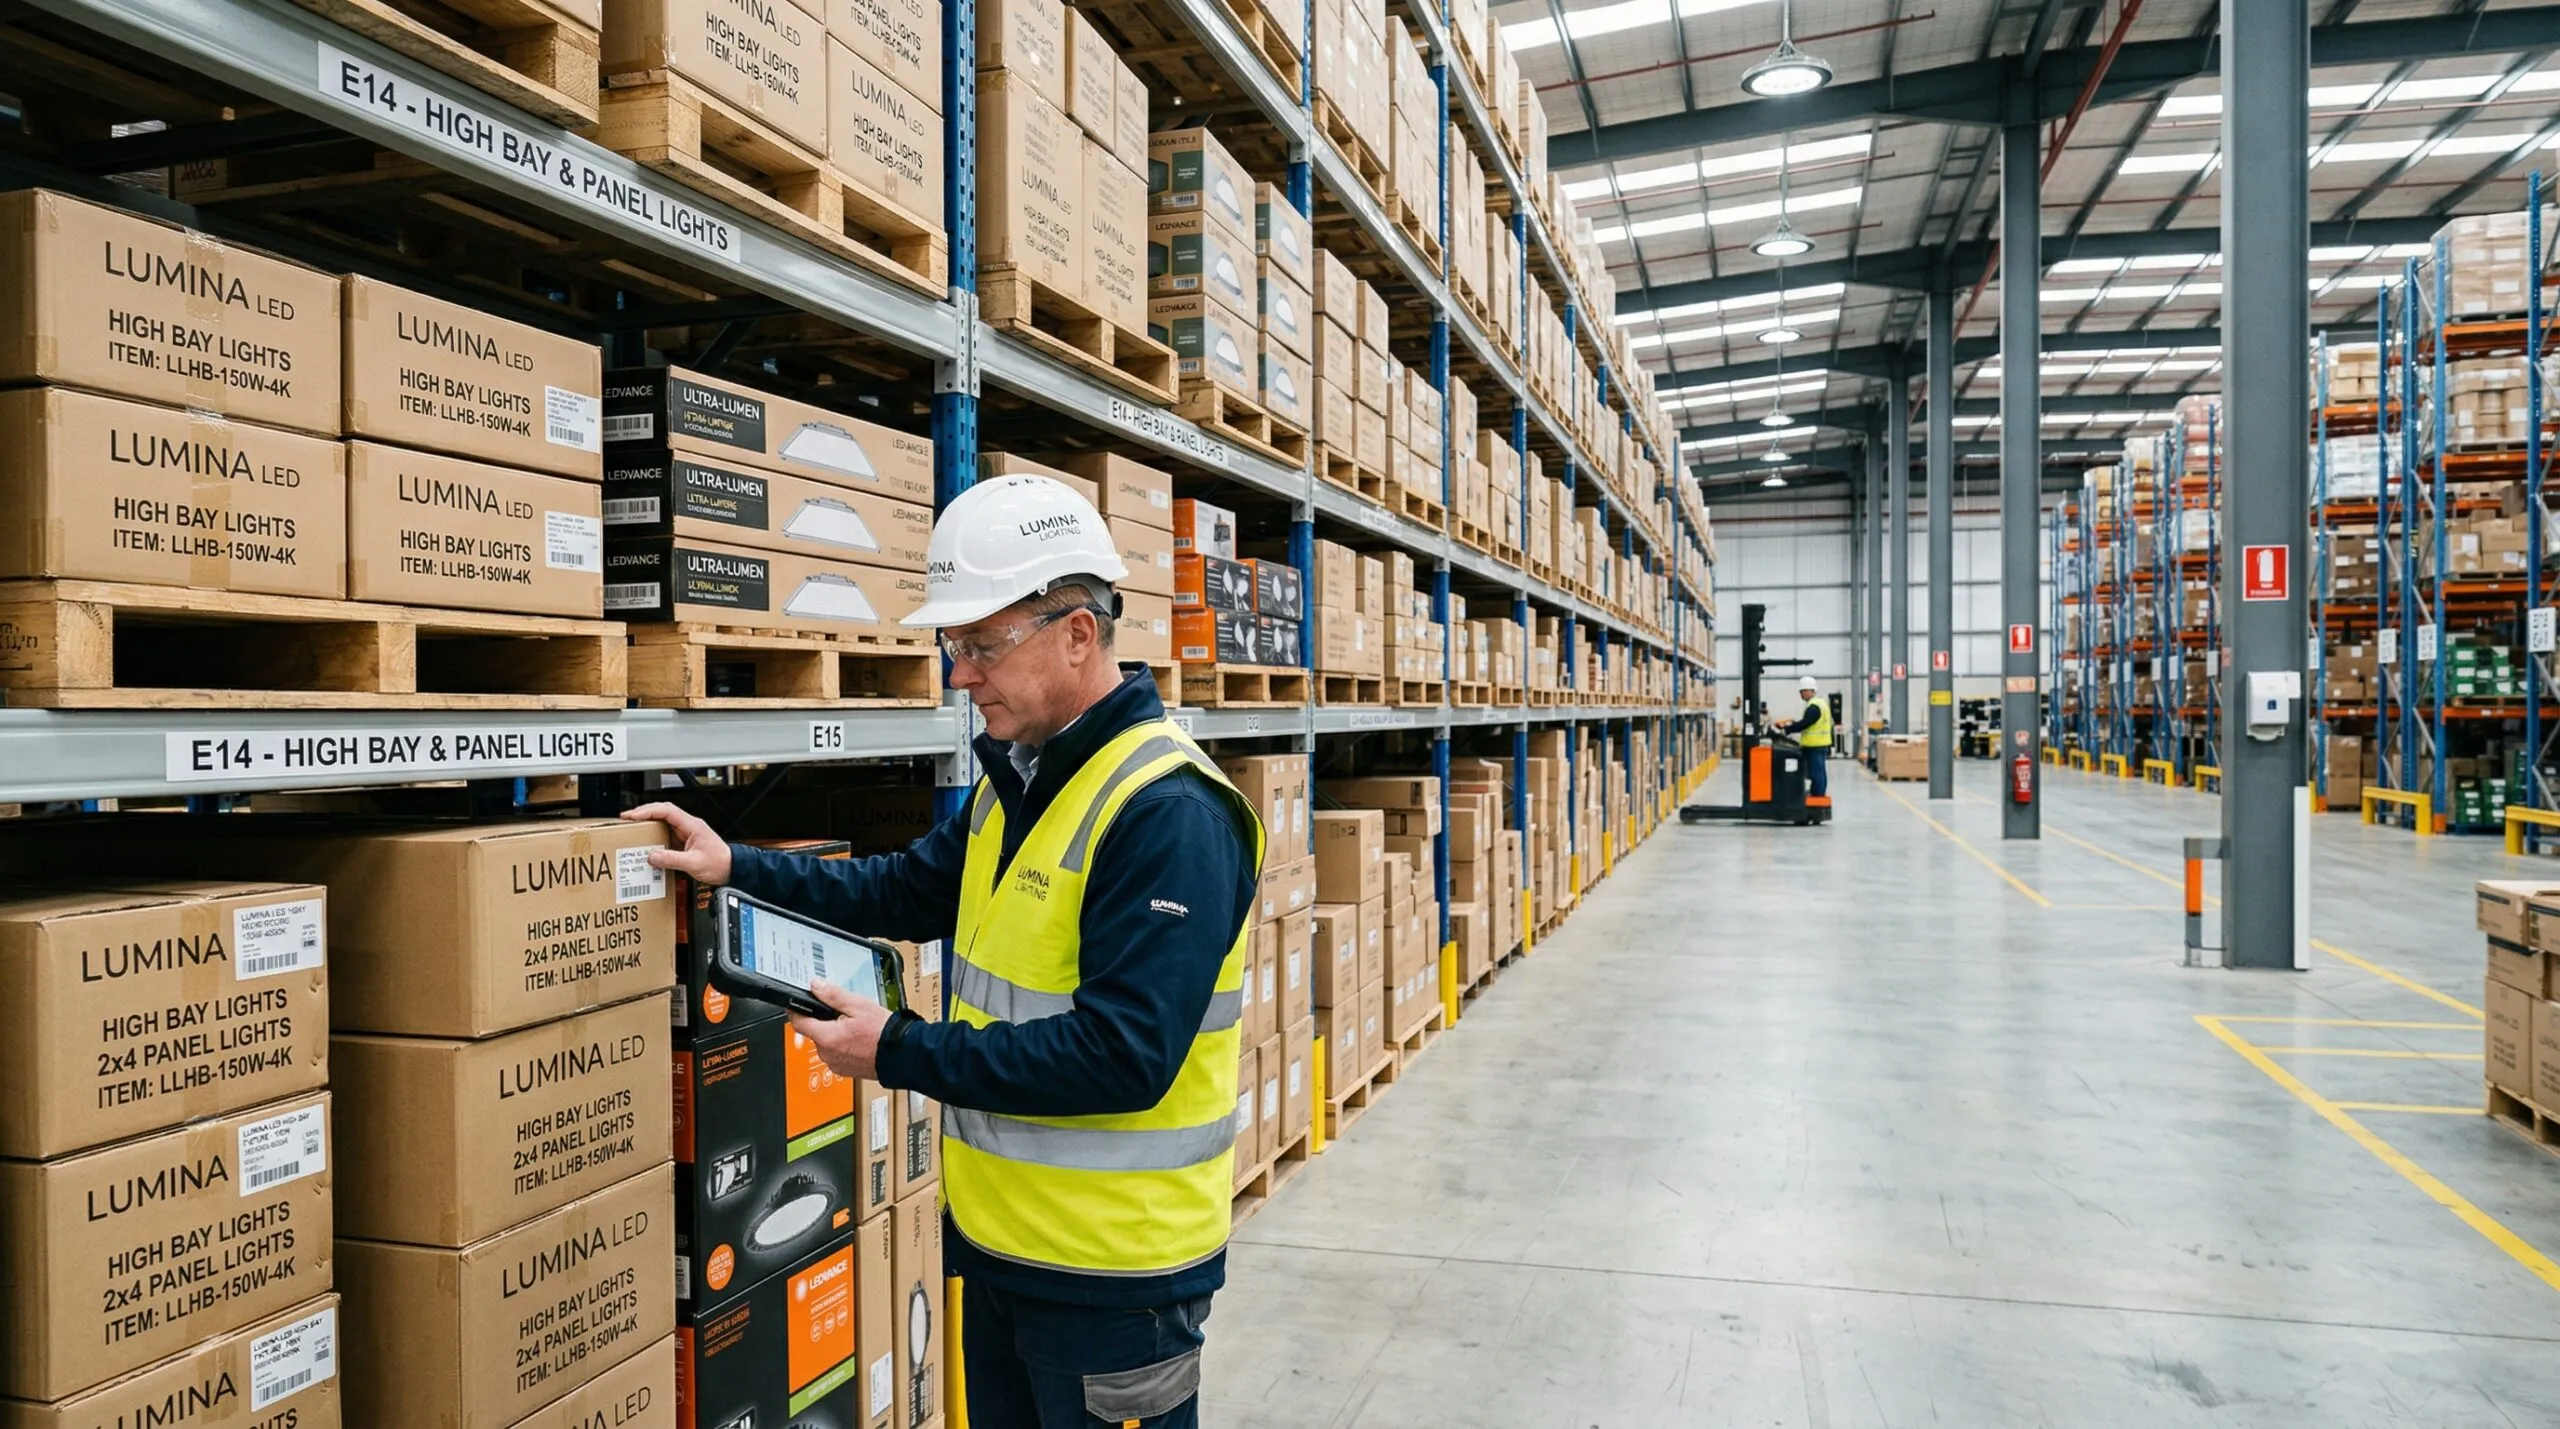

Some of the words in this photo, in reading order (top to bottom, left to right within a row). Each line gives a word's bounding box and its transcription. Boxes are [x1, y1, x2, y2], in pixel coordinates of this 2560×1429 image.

[706, 11, 734, 44] HIGH
[738, 32, 760, 59] BAY
[762, 47, 799, 84] LIGHTS
[706, 37, 732, 65] ITEM:
[779, 14, 800, 46] LED
[852, 70, 906, 126] LUMINA
[341, 61, 396, 112] E14
[408, 105, 416, 113] -
[426, 102, 493, 152] HIGH
[504, 132, 551, 176] BAY
[559, 159, 575, 188] &
[584, 167, 653, 221] PANEL
[660, 200, 728, 250] LIGHTS
[106, 241, 250, 309] LUMINA
[257, 295, 295, 320] LED
[109, 309, 164, 342] HIGH
[172, 324, 213, 352] BAY
[220, 336, 291, 372] LIGHTS
[398, 312, 500, 364] LUMINA
[506, 351, 534, 372] LED
[109, 341, 160, 369] ITEM:
[167, 354, 291, 398] LLHB-150W-4K
[400, 367, 440, 394] HIGH
[444, 378, 474, 401] BAY
[479, 386, 531, 414] LIGHTS
[604, 385, 654, 398] EDVANCE
[400, 394, 436, 417] ITEM:
[441, 403, 531, 437] LLHB-150W-4K
[684, 387, 760, 420] ULTRA-LUMEN
[111, 429, 254, 482] LUMINA
[262, 464, 300, 488] LED
[608, 468, 662, 480] LEDVANCE
[686, 468, 763, 497] ULTRA-LUMEN
[114, 496, 168, 524] HIGH
[176, 505, 218, 530] BAY
[225, 511, 296, 539] LIGHTS
[399, 474, 500, 515] LUMINA
[506, 500, 533, 520] LED
[114, 529, 165, 552] ITEM:
[172, 535, 296, 566] LLHB-150W-4K
[400, 530, 440, 552] HIGH
[445, 535, 475, 556] BAY
[480, 540, 531, 562] LIGHTS
[1020, 514, 1079, 536] LUMINA
[400, 556, 436, 576] ITEM:
[442, 561, 532, 584] LLHB-150W-4K
[608, 554, 660, 566] LEDVANCE
[688, 556, 764, 579] ULTRA-LUMEN
[193, 739, 252, 771] E14
[285, 737, 358, 766] HIGH
[368, 736, 421, 763] BAY
[429, 737, 447, 761] &
[456, 734, 531, 760] PANEL
[540, 732, 614, 759] LIGHTS
[814, 726, 842, 748] E15
[850, 808, 929, 826] LUMINA
[512, 852, 612, 894] LUMINA
[528, 916, 561, 940] HIGH
[565, 913, 590, 934] BAY
[594, 905, 638, 928] LIGHTS
[82, 933, 227, 982] LUMINA
[524, 946, 548, 967] 2x4
[552, 940, 594, 961] PANEL
[598, 928, 641, 951] LIGHTS
[525, 971, 558, 992] ITEM:
[562, 951, 642, 984] LLHB-150W-4K
[103, 1012, 158, 1042] HIGH
[166, 1002, 209, 1030] BAY
[216, 988, 288, 1020] LIGHTS
[98, 1048, 137, 1076] 2x4
[144, 1034, 214, 1066] PANEL
[220, 1017, 292, 1050] LIGHTS
[500, 1042, 604, 1100] LUMINA
[610, 1034, 645, 1065] LED
[98, 1078, 154, 1108] ITEM:
[160, 1046, 292, 1094] LLHB-150W-4K
[517, 1115, 551, 1142] HIGH
[556, 1105, 582, 1129] BAY
[586, 1089, 631, 1119] LIGHTS
[514, 1147, 537, 1170] 2x4
[542, 1131, 585, 1160] PANEL
[590, 1112, 634, 1142] LIGHTS
[514, 1171, 548, 1196] ITEM:
[552, 1135, 634, 1181] LLHB-150W-4K
[88, 1154, 228, 1222] LUMINA
[109, 1241, 163, 1278] HIGH
[171, 1225, 212, 1256] BAY
[219, 1201, 290, 1242] LIGHTS
[503, 1227, 607, 1299] LUMINA
[612, 1211, 648, 1247] LED
[104, 1281, 142, 1312] 2x4
[150, 1257, 218, 1297] PANEL
[224, 1229, 294, 1270] LIGHTS
[104, 1311, 160, 1345] ITEM:
[166, 1256, 296, 1322] LLHB-150W-4K
[520, 1306, 554, 1340] HIGH
[559, 1291, 584, 1320] BAY
[589, 1268, 634, 1305] LIGHTS
[516, 1346, 540, 1368] 2x4
[544, 1322, 588, 1352] PANEL
[592, 1290, 637, 1327] LIGHTS
[517, 1370, 550, 1394] ITEM:
[555, 1314, 638, 1373] LLHB-150W-4K
[97, 1372, 238, 1429] UMINA
[615, 1386, 650, 1427] LED
